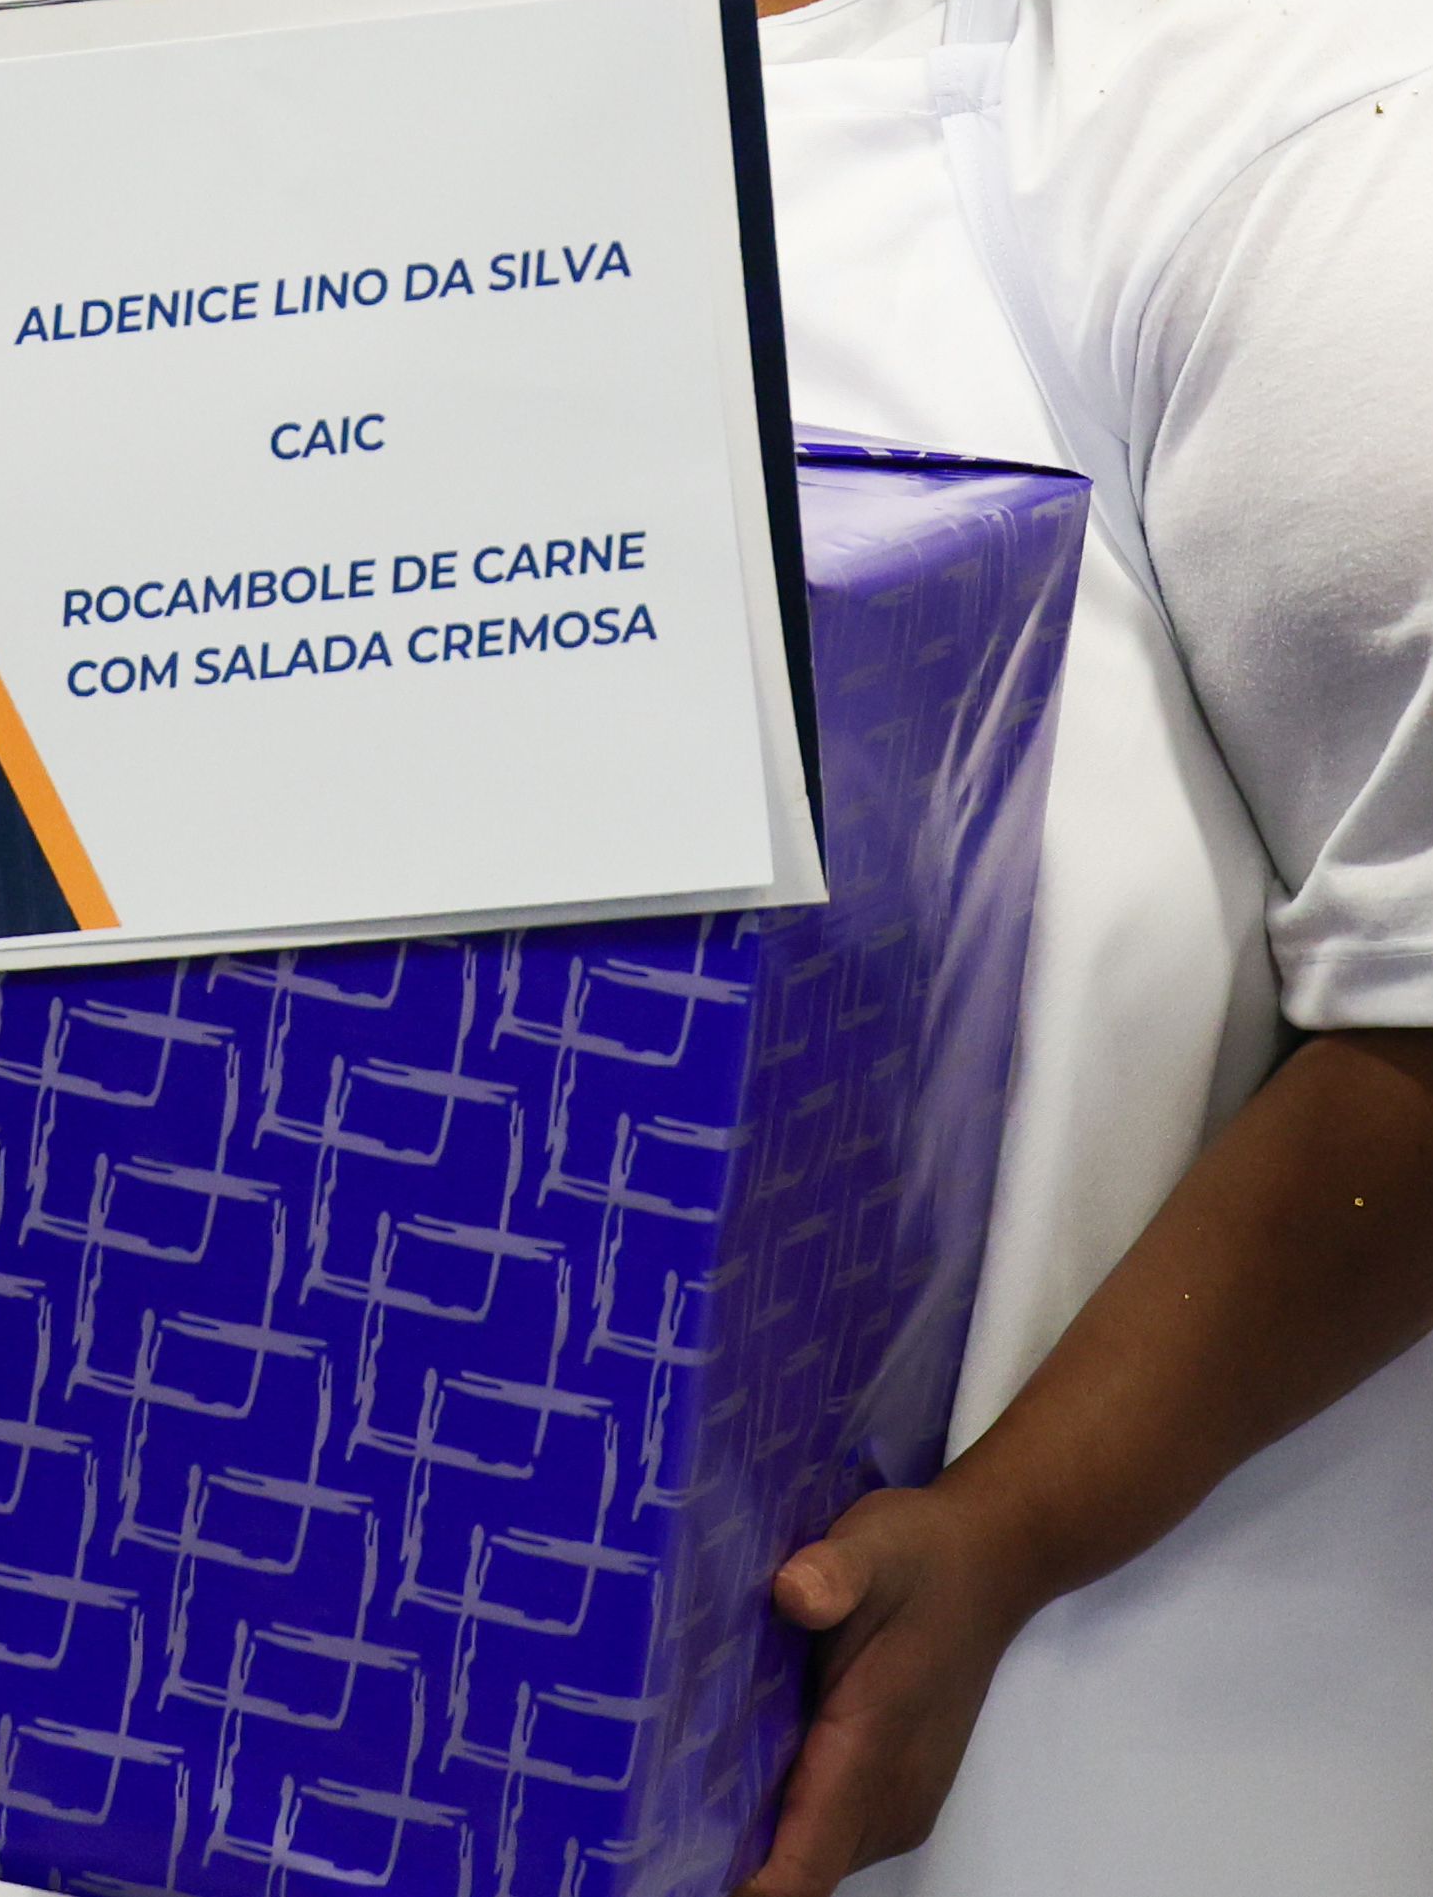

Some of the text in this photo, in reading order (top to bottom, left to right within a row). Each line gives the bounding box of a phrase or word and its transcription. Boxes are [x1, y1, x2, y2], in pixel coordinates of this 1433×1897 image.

[14, 240, 631, 346] ALDENICE LINO DA SILVA
[270, 413, 385, 461] CAIC
[62, 531, 646, 628] ROCAMBOLE DE CARNE
[67, 603, 657, 698] COM SALADA CREMOSA
